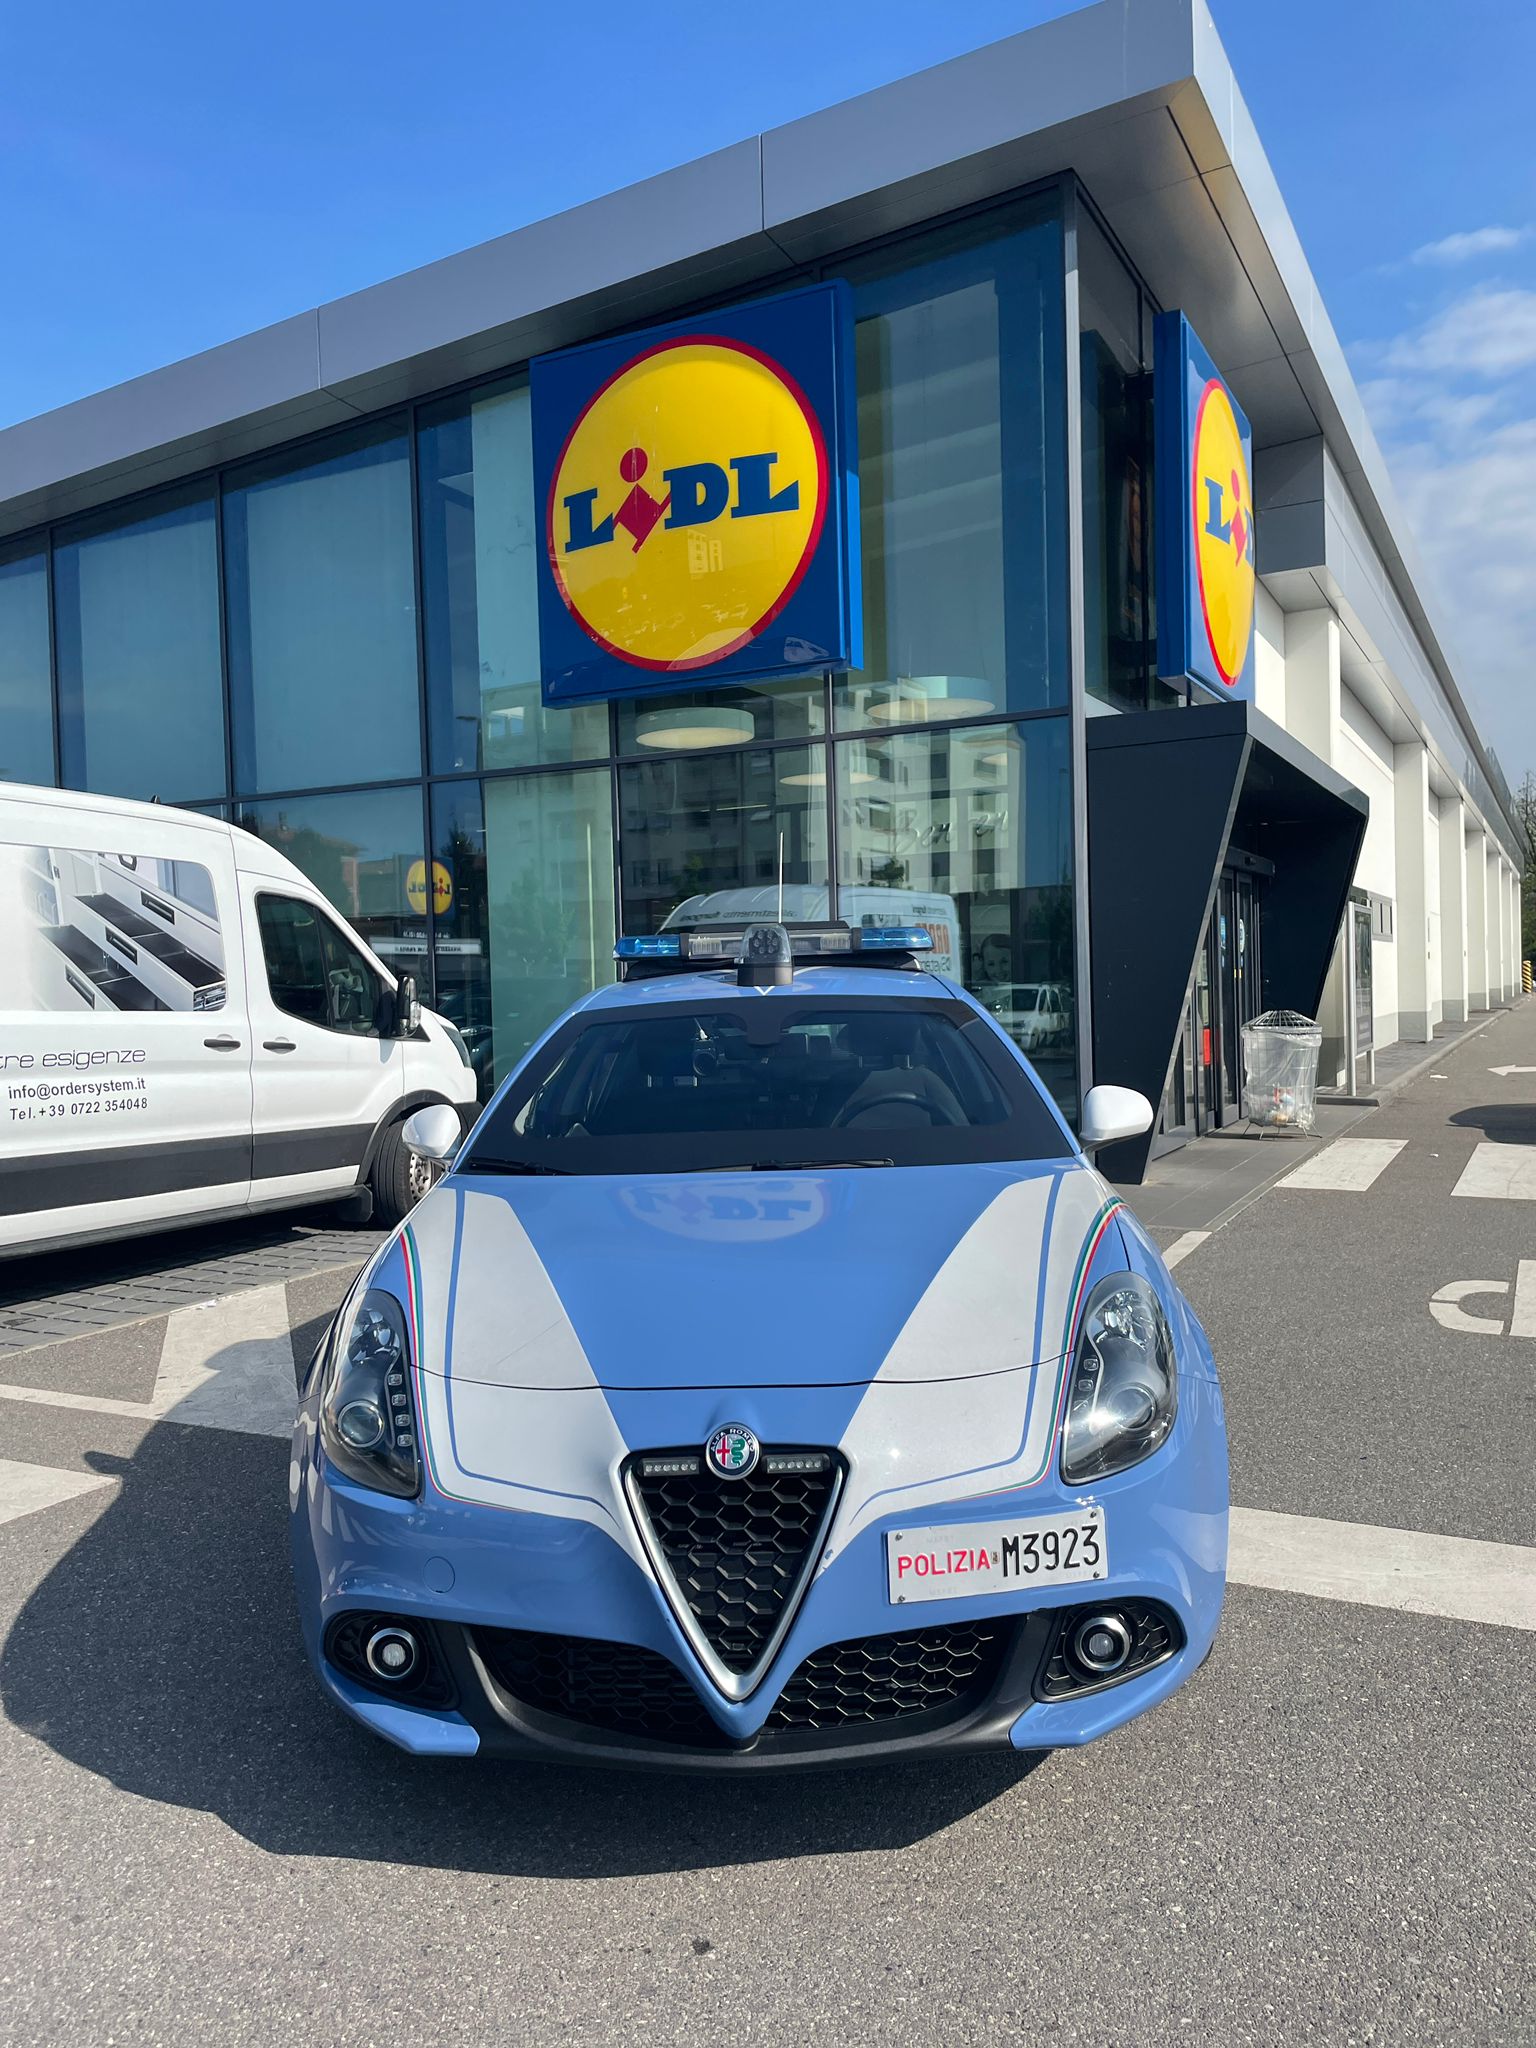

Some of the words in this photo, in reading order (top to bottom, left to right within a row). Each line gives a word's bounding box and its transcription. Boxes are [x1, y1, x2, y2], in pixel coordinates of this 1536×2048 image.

[42, 1048, 147, 1071] esigenze
[8, 1077, 147, 1100] info@ordersystem.it
[71, 1101, 101, 1116] 0722
[105, 1098, 148, 1112] 354048
[710, 1431, 727, 1453] ALFA
[729, 1428, 755, 1452] ROMEO
[897, 1547, 991, 1579] POLIZIA
[1001, 1524, 1100, 1577] M3923
